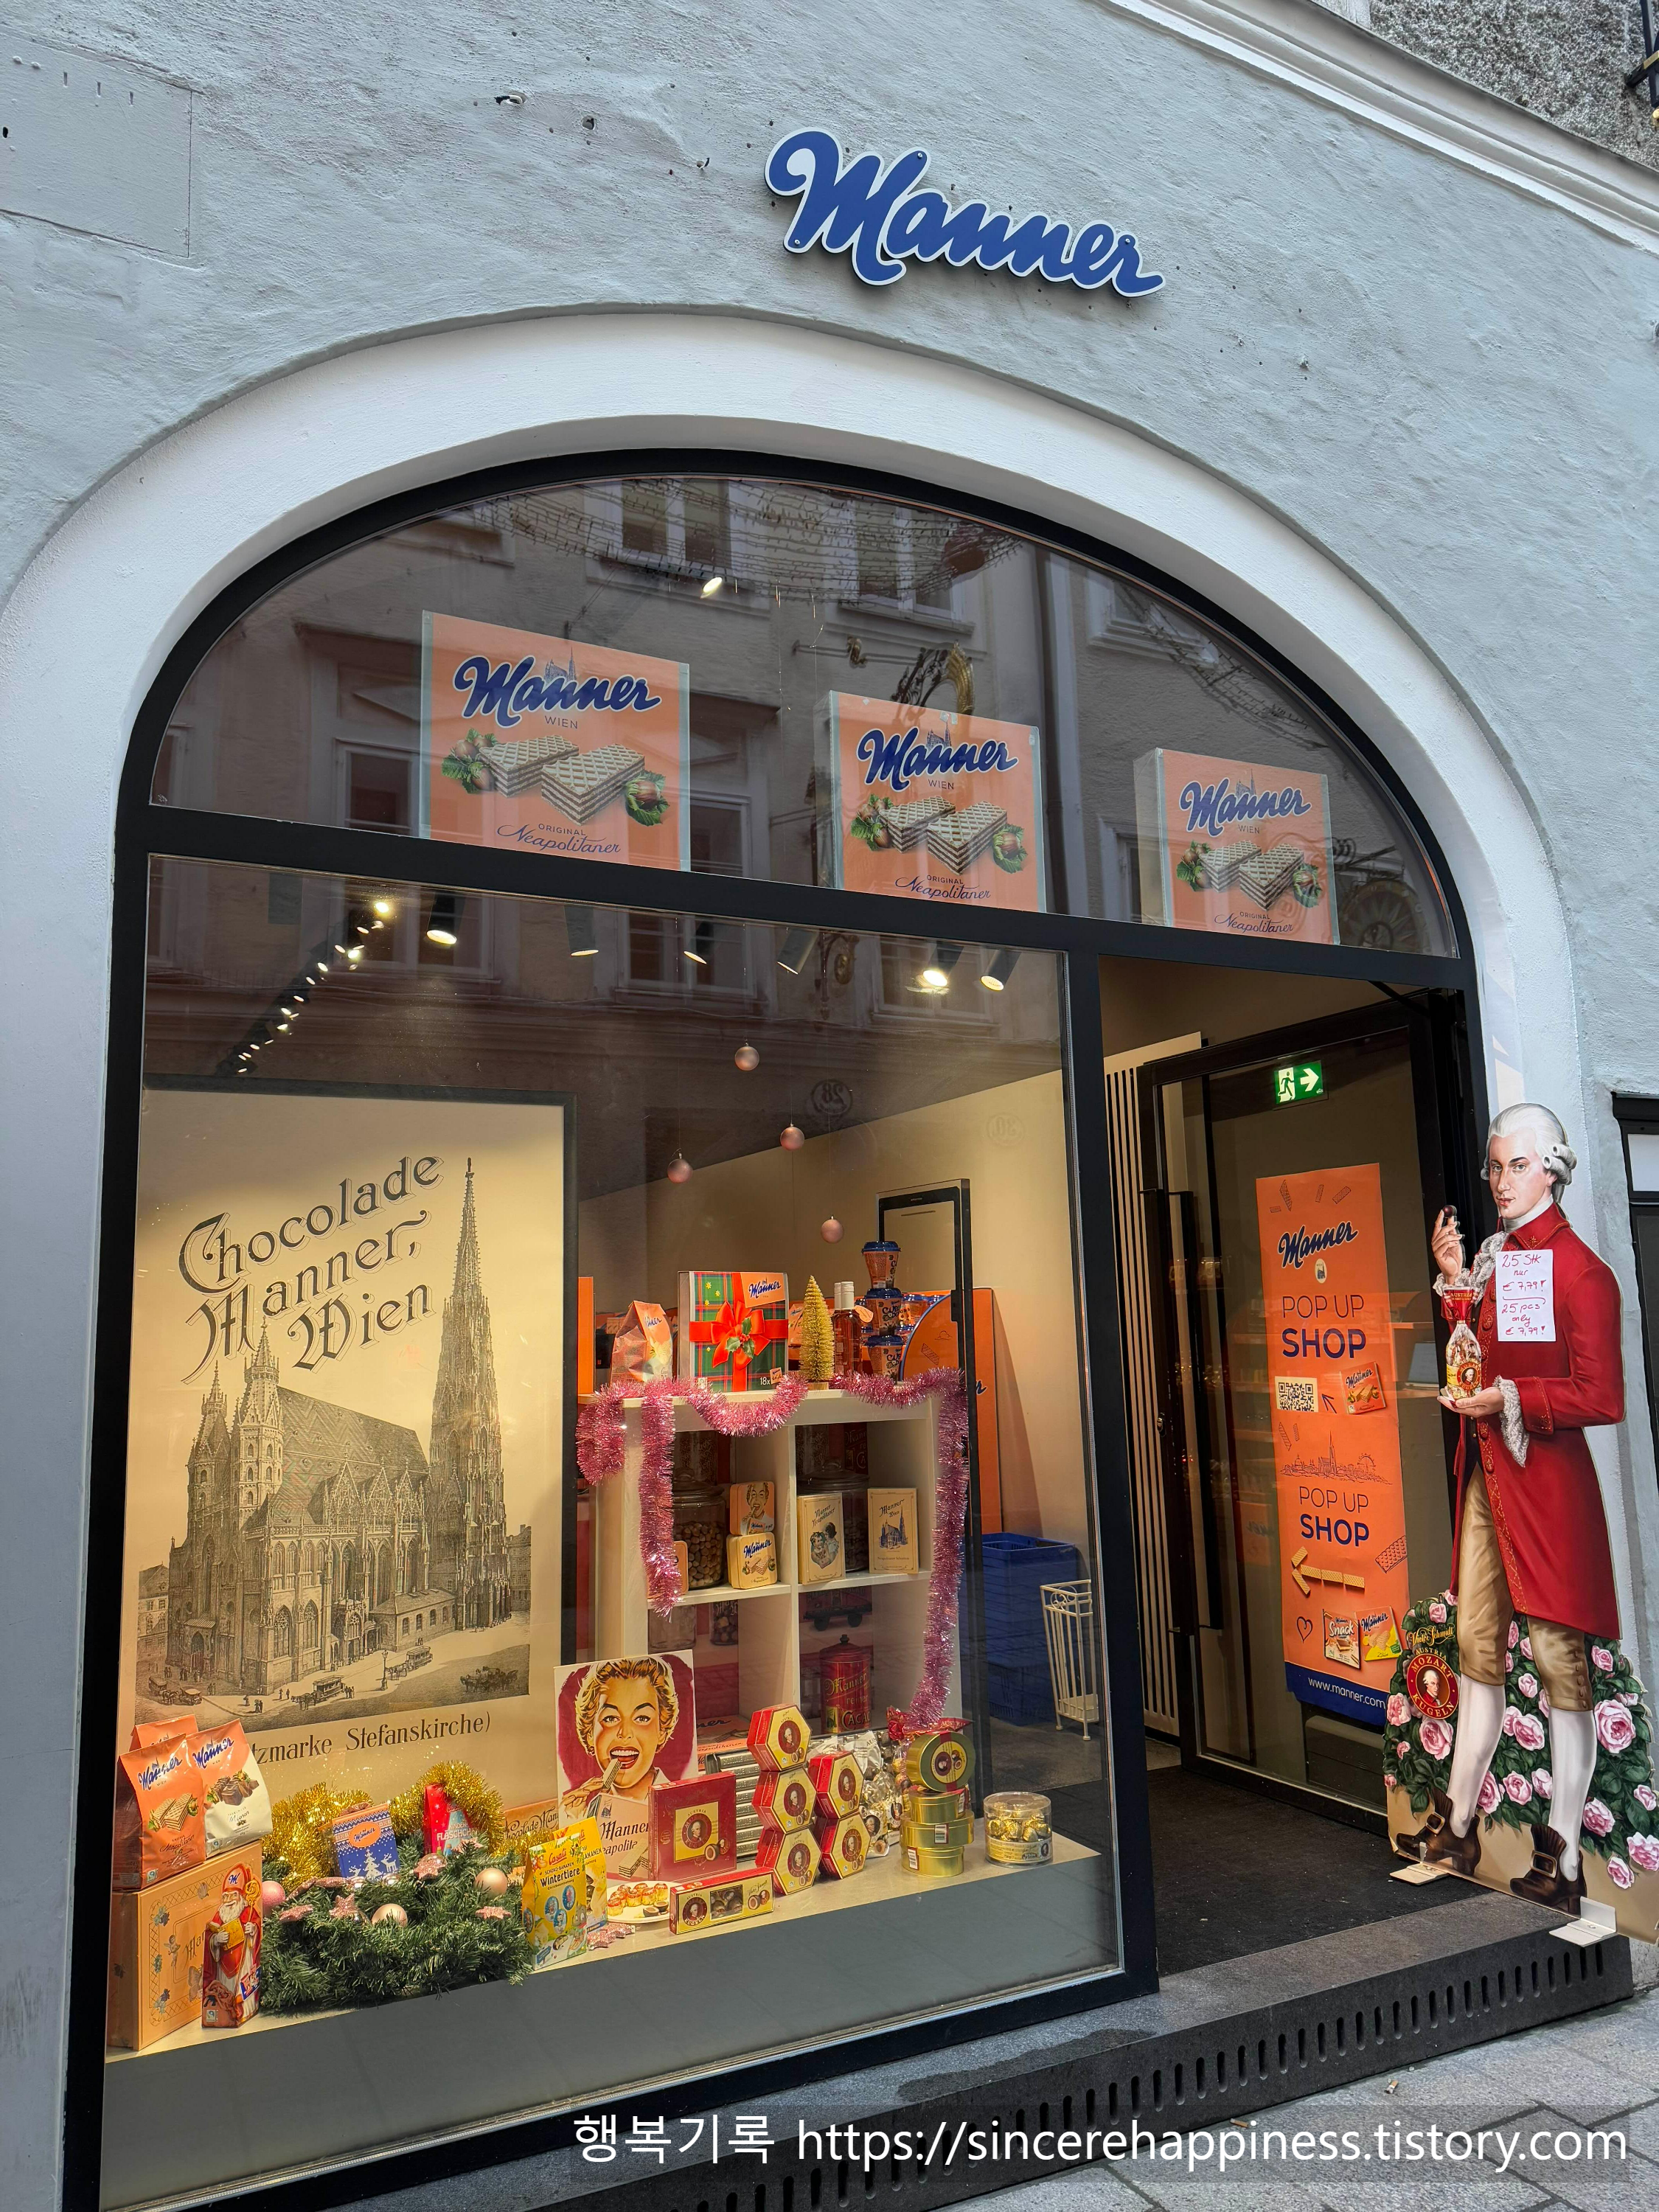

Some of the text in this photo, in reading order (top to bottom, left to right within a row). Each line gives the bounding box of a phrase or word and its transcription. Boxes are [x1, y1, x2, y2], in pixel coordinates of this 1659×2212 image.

[765, 127, 1166, 297] Manner
[453, 655, 662, 728] Manner
[544, 715, 579, 728] WIEN
[856, 726, 1019, 792] Manner
[928, 779, 955, 790] WIEN
[1179, 777, 1312, 837] Manner
[497, 824, 621, 853] Neapolitaner
[538, 823, 586, 837] ORIGINAL
[1238, 824, 1260, 834] WIEN
[895, 877, 991, 900] Neapolitaner
[926, 874, 964, 885] ORIGINAL
[1214, 913, 1294, 933] Neapolitaner
[1239, 911, 1270, 919] ORIGINAL
[178, 1155, 444, 1297] Chocolade
[1278, 1220, 1359, 1269] Manner
[1502, 1253, 1541, 1267] 25 Stk
[748, 1279, 782, 1298] Manner
[1282, 1294, 1365, 1318] POP UP
[1501, 1302, 1540, 1315] 25 pcs
[287, 1283, 437, 1373] Wien
[1512, 1314, 1531, 1326] only
[1281, 1327, 1367, 1360] SHOP
[759, 1377, 771, 1386] 18x
[1346, 1368, 1373, 1389] Manner
[879, 1498, 905, 1517] Manner
[1299, 1486, 1369, 1513] POP UP
[1300, 1514, 1370, 1547] SHOP
[743, 1539, 772, 1559] Manner
[1329, 1620, 1354, 1638] Snack
[1360, 1613, 1389, 1632] Manner
[1416, 1648, 1447, 1661] AUSTRIA
[1411, 1655, 1453, 1679] MOZART
[824, 1672, 867, 1697] Manner
[1307, 1677, 1386, 1708] www.manner.com
[1412, 1694, 1455, 1717] KUGELN
[347, 1711, 491, 1750] Stefanskirche)
[192, 1737, 234, 1769] Manner
[138, 1756, 183, 1791] Manner
